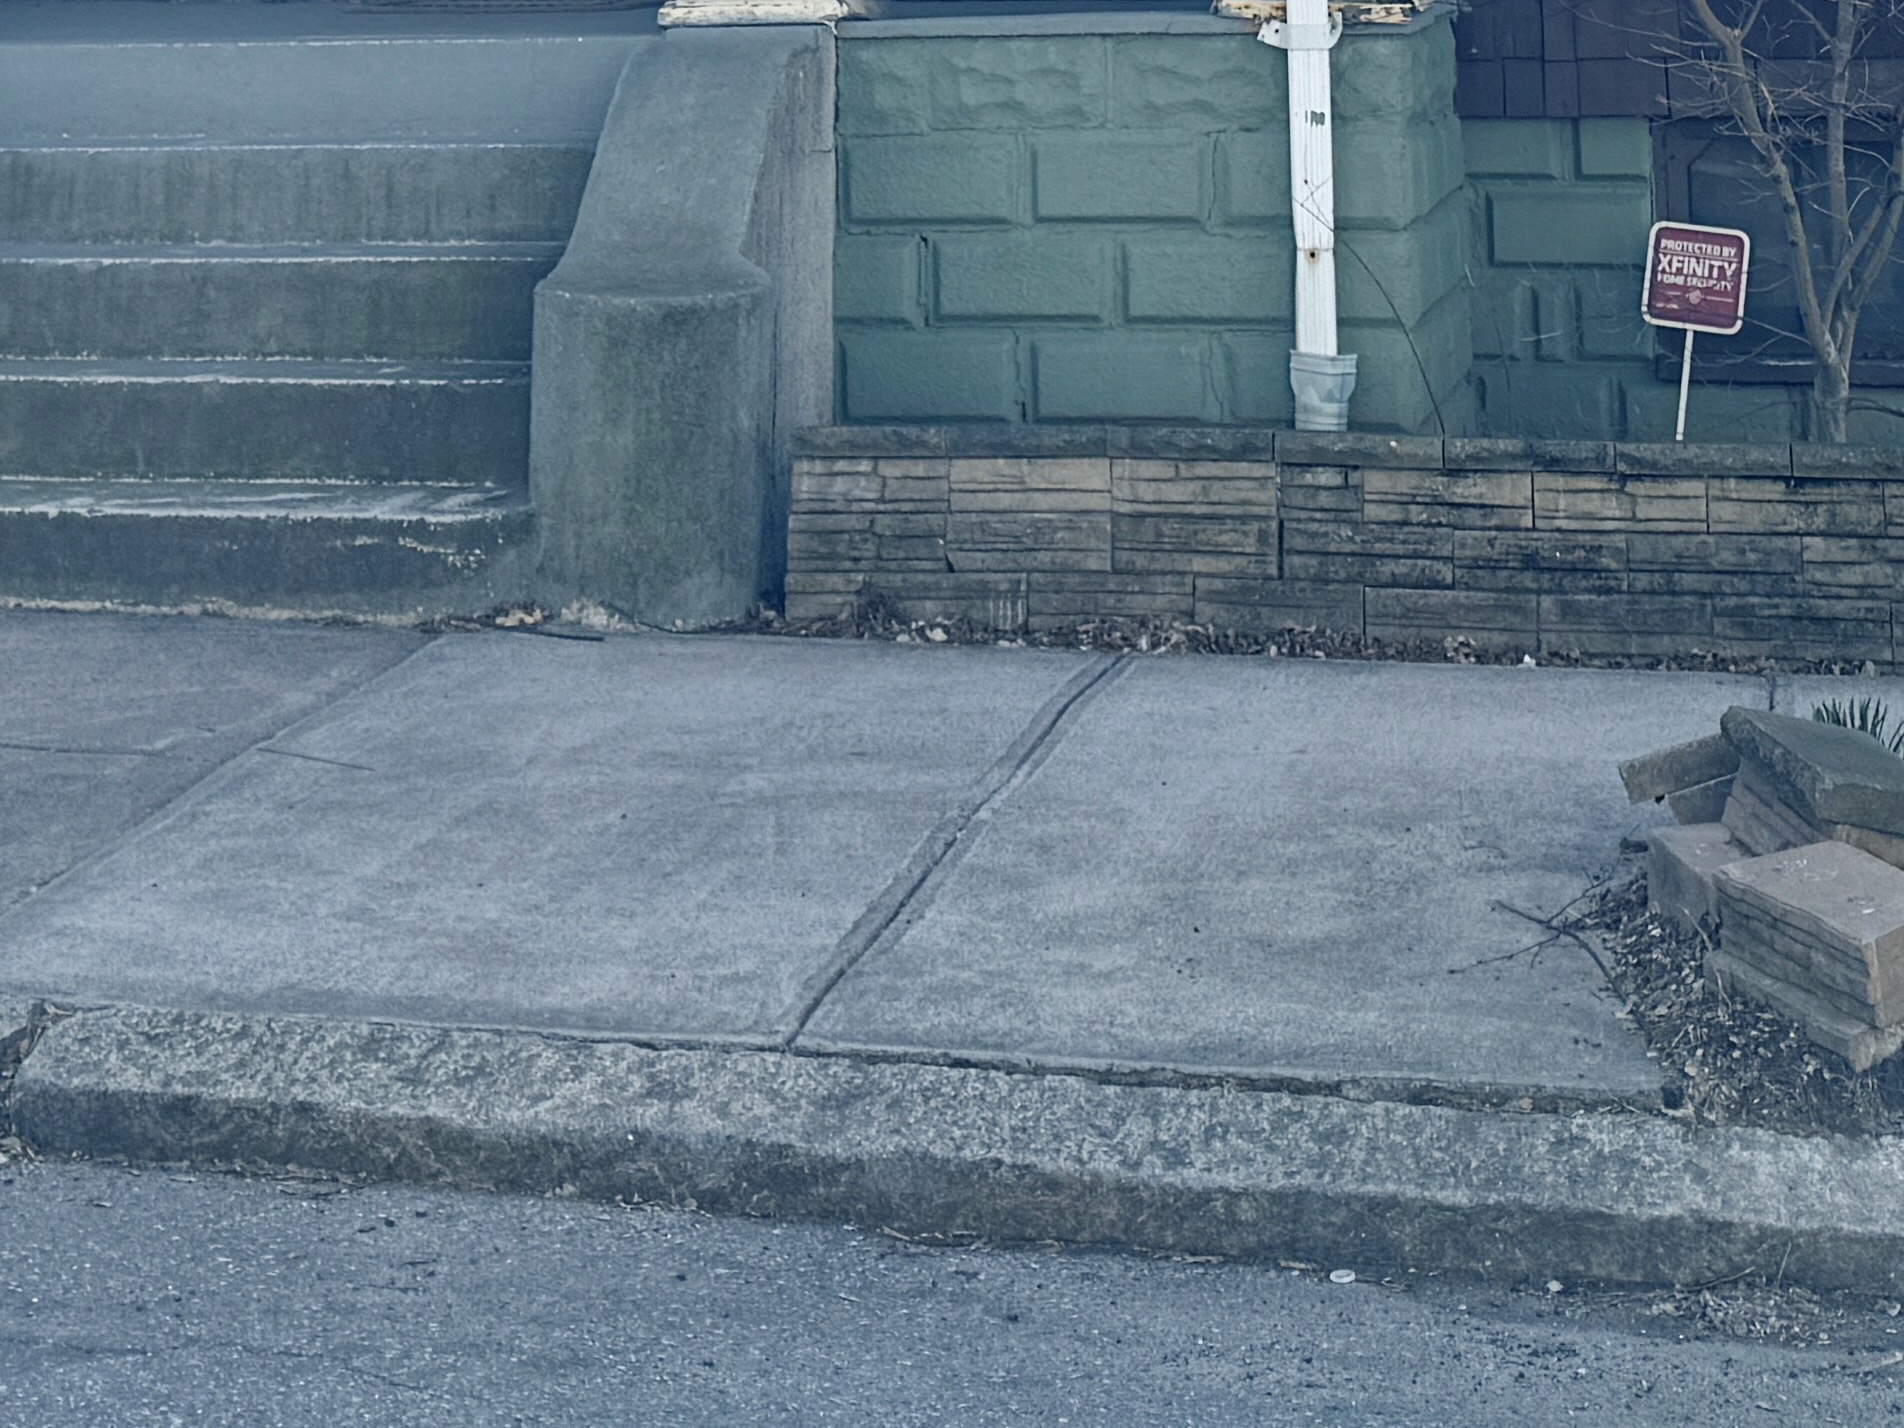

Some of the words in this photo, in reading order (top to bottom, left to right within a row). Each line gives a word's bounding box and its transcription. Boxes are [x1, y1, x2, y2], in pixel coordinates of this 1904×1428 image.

[1660, 239, 1721, 256] PROTECTED
[1722, 246, 1737, 257] BY
[1657, 253, 1737, 278] XFINITY
